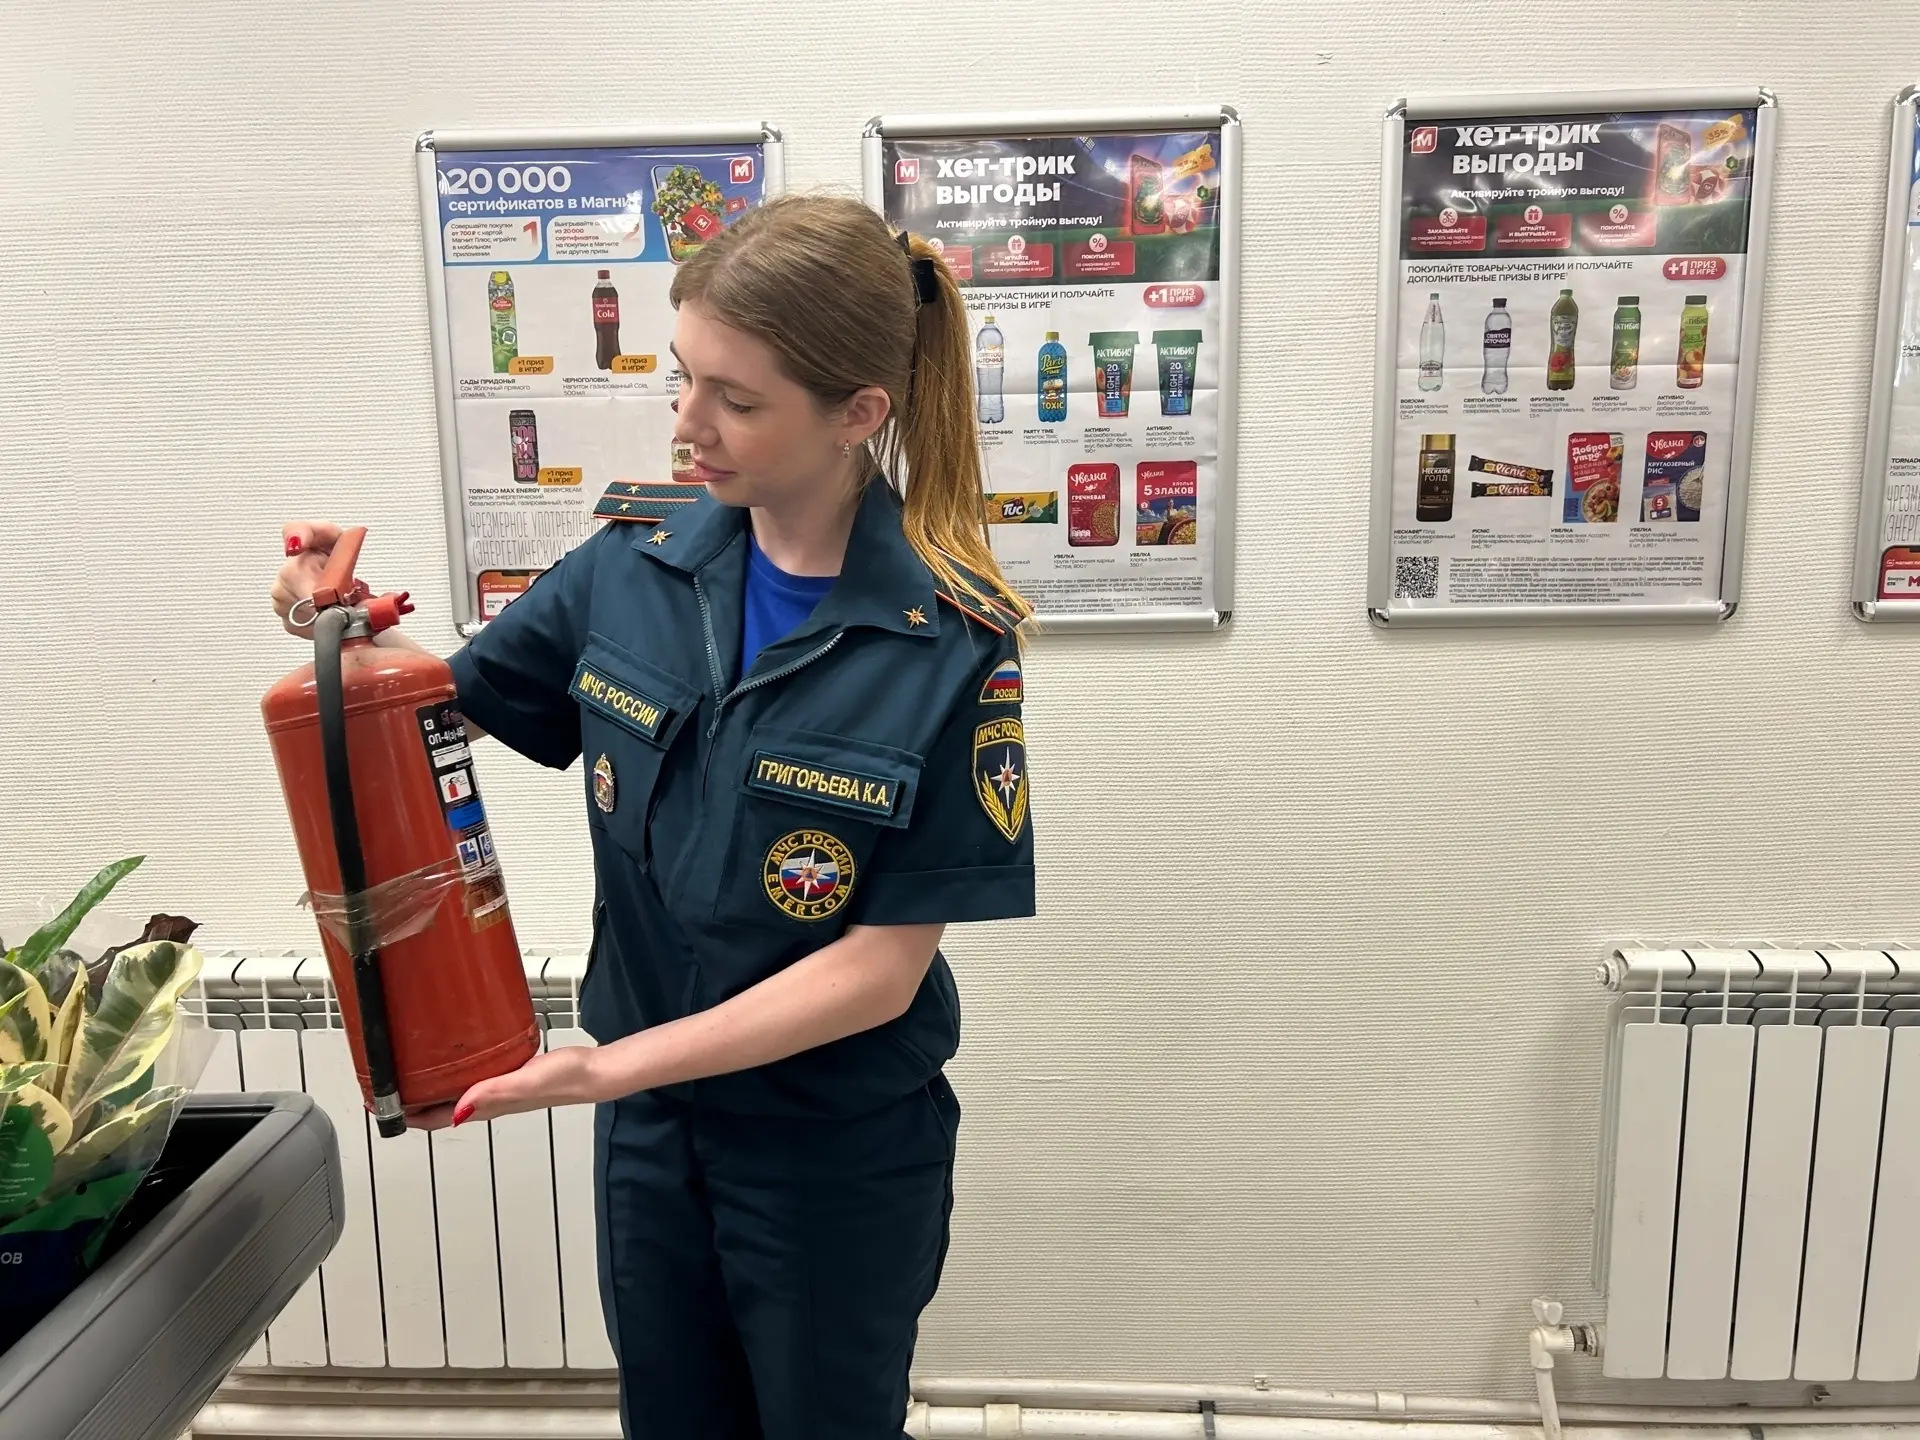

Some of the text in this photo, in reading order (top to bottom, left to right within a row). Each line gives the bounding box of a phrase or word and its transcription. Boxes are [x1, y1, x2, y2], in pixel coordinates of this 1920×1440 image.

[1416, 132, 1432, 147] М
[1456, 123, 1600, 150] хет-трик
[937, 155, 1076, 181] хет-трик
[1453, 152, 1583, 175] выгоды
[900, 166, 915, 179] М
[446, 166, 571, 195] 20 000
[937, 182, 1060, 206] выгоды
[1450, 186, 1625, 200] Активируйте тройную выгоду!
[449, 196, 564, 215] сертификатов
[568, 198, 577, 209] в
[936, 215, 1103, 230] Активируйте тройную выгоду!
[523, 221, 538, 245] 1
[1408, 260, 1633, 274] ПОКУПАЙТЕ ТОВАРЫ-УЧАСТНИКИ И ПОЛУЧАЙТЕ
[1668, 261, 1688, 275] +1
[1690, 260, 1717, 269] ПРИЗ
[1408, 274, 1497, 284] ДОПОЛНИТЕЛЬНЫЕ
[1498, 273, 1532, 282] ПРИЗЫ
[961, 292, 1049, 301] ОВАРЫ-УЧАСТНИКИ
[1060, 288, 1115, 299] ПОЛУЧАЙТЕ
[1148, 289, 1168, 304] +1
[1170, 288, 1195, 296] ПРИЗ
[988, 302, 1018, 311] ПРИЗЫ
[597, 310, 615, 318] Cola
[1097, 348, 1132, 357] АКТИБИО
[1160, 346, 1195, 356] АКТИБИО
[1042, 402, 1064, 410] TOXIC
[1572, 443, 1609, 456] Доброе
[1651, 438, 1684, 452] Увелка
[1573, 452, 1602, 464] утро
[556, 470, 574, 478] приз
[1141, 470, 1165, 480] Увелка
[1424, 474, 1448, 482] ГОЛД
[1496, 464, 1526, 478] Picnic
[1070, 472, 1107, 487] Увелка
[1144, 485, 1194, 496] 5 ЗЛАКОВ
[1499, 484, 1529, 495] Picnic
[1657, 498, 1664, 507] 5
[470, 512, 528, 538] ЧРЕЗМЕРНОЕ
[579, 672, 660, 728] МЧС РОССИИ
[978, 725, 1001, 744] МЧС
[757, 760, 890, 807] ГРИГОРЬЕВА К.А.
[770, 834, 852, 876] МЧС РОССИИ
[768, 874, 850, 916] EMERCOM
